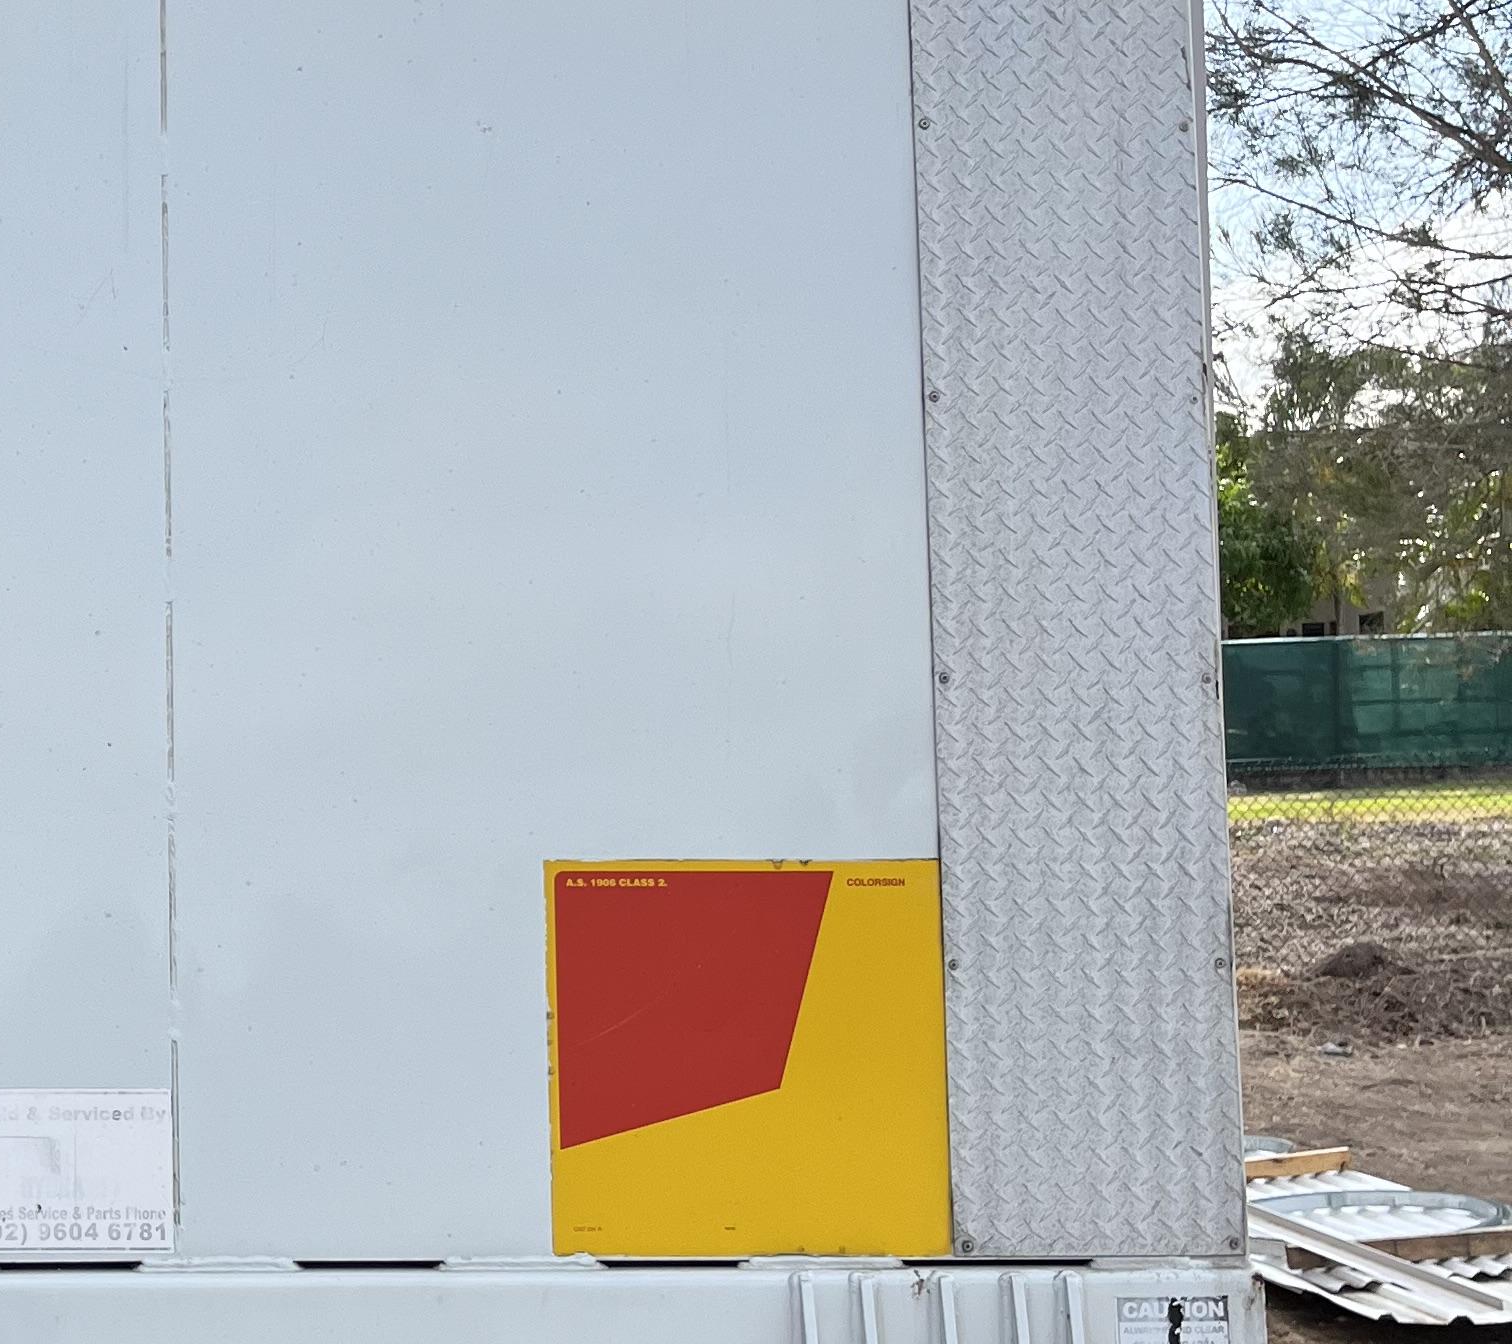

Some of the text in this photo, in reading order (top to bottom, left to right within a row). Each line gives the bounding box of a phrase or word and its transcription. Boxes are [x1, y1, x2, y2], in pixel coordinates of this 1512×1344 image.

[618, 878, 655, 887] CLASS
[846, 877, 906, 887] COLORSIGN
[47, 1106, 135, 1121] Serviced
[18, 1206, 68, 1221] Service
[71, 1206, 82, 1220] &
[86, 1206, 122, 1220] Parts
[39, 1222, 99, 1241] 9604
[107, 1222, 167, 1241] 6781
[1122, 1301, 1225, 1318] CAUION
